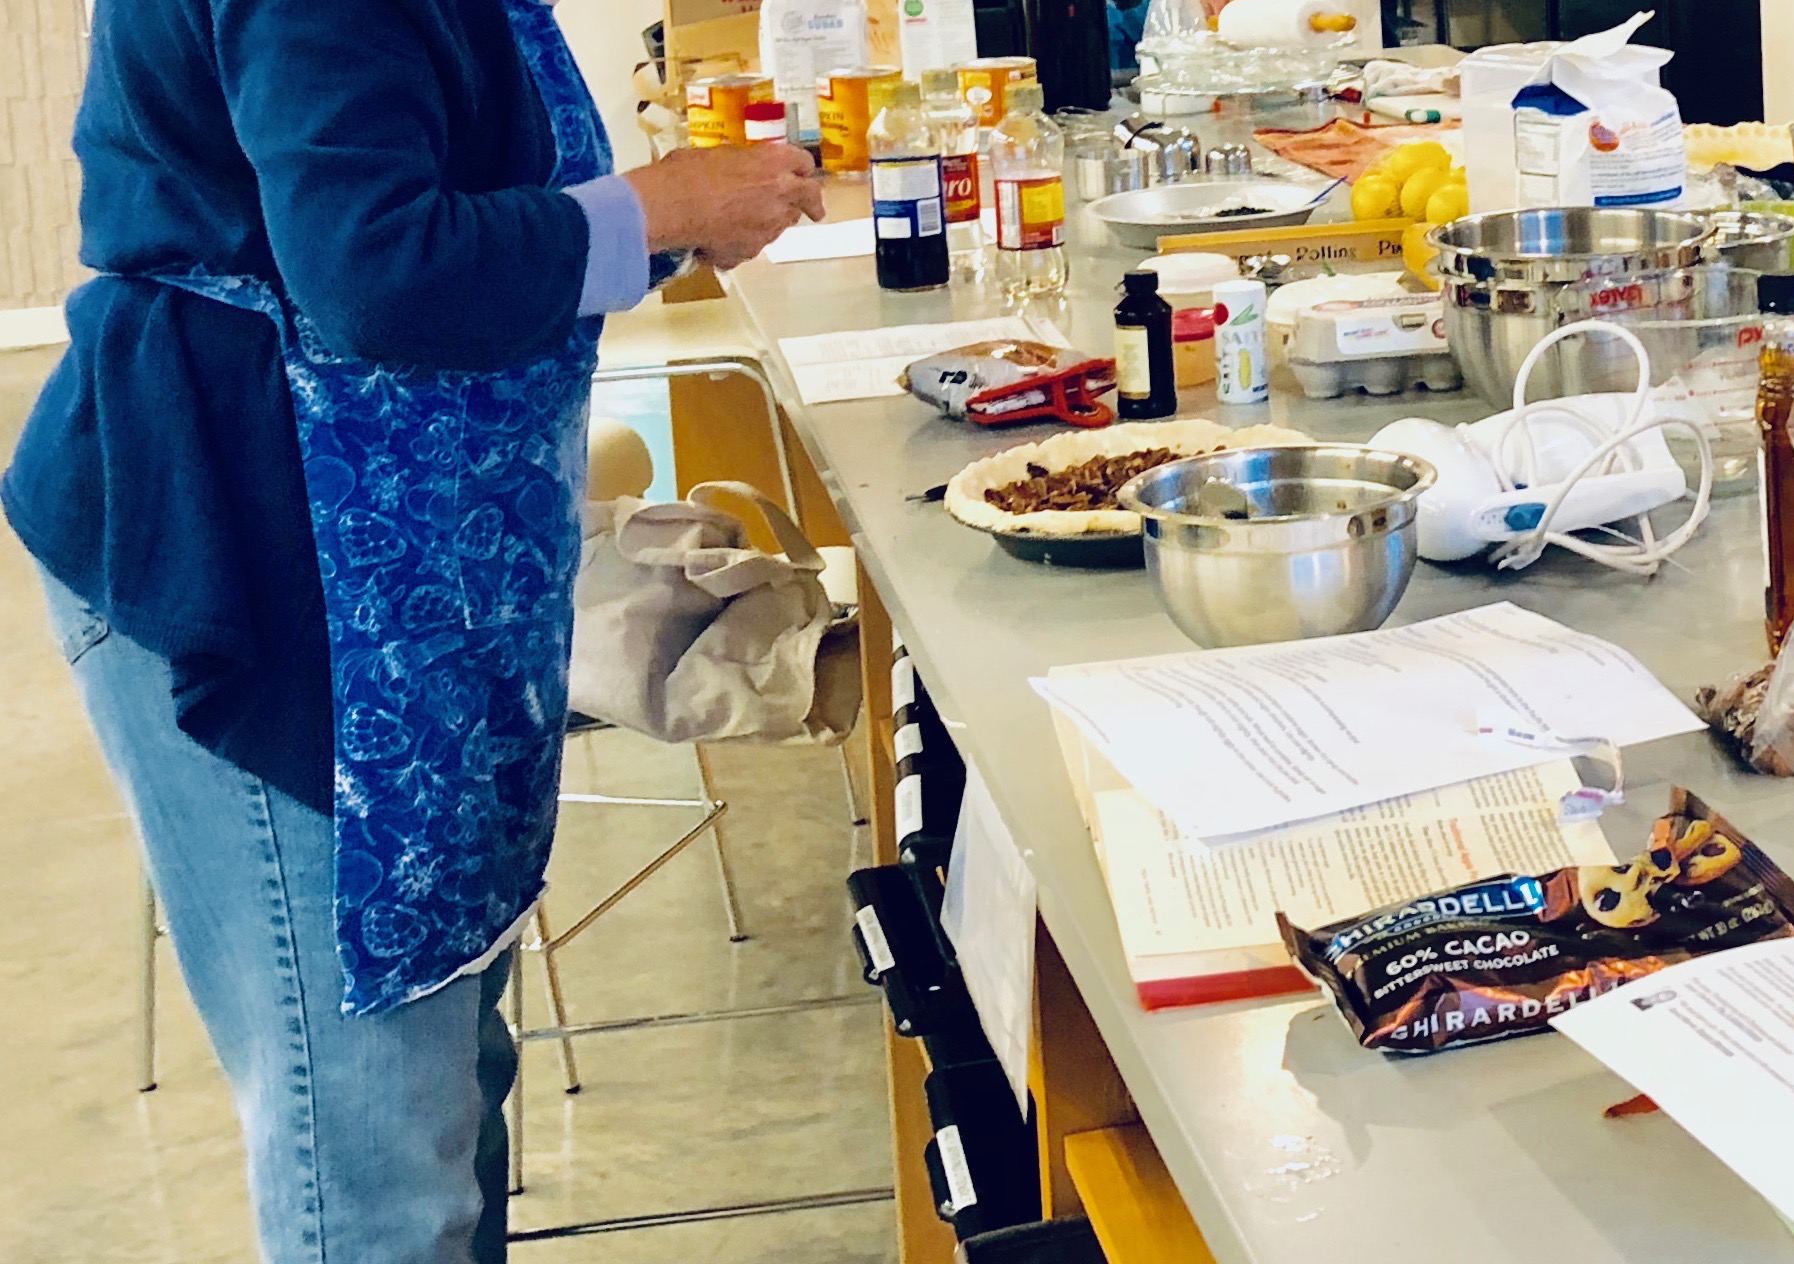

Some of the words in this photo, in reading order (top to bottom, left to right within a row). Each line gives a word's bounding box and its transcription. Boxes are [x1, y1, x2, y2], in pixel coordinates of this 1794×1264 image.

[1373, 958, 1470, 1000] BITTERSWEET
[1472, 943, 1560, 971] CHOCOLATE
[1385, 946, 1438, 976] 60%
[1444, 930, 1530, 956] CACAO
